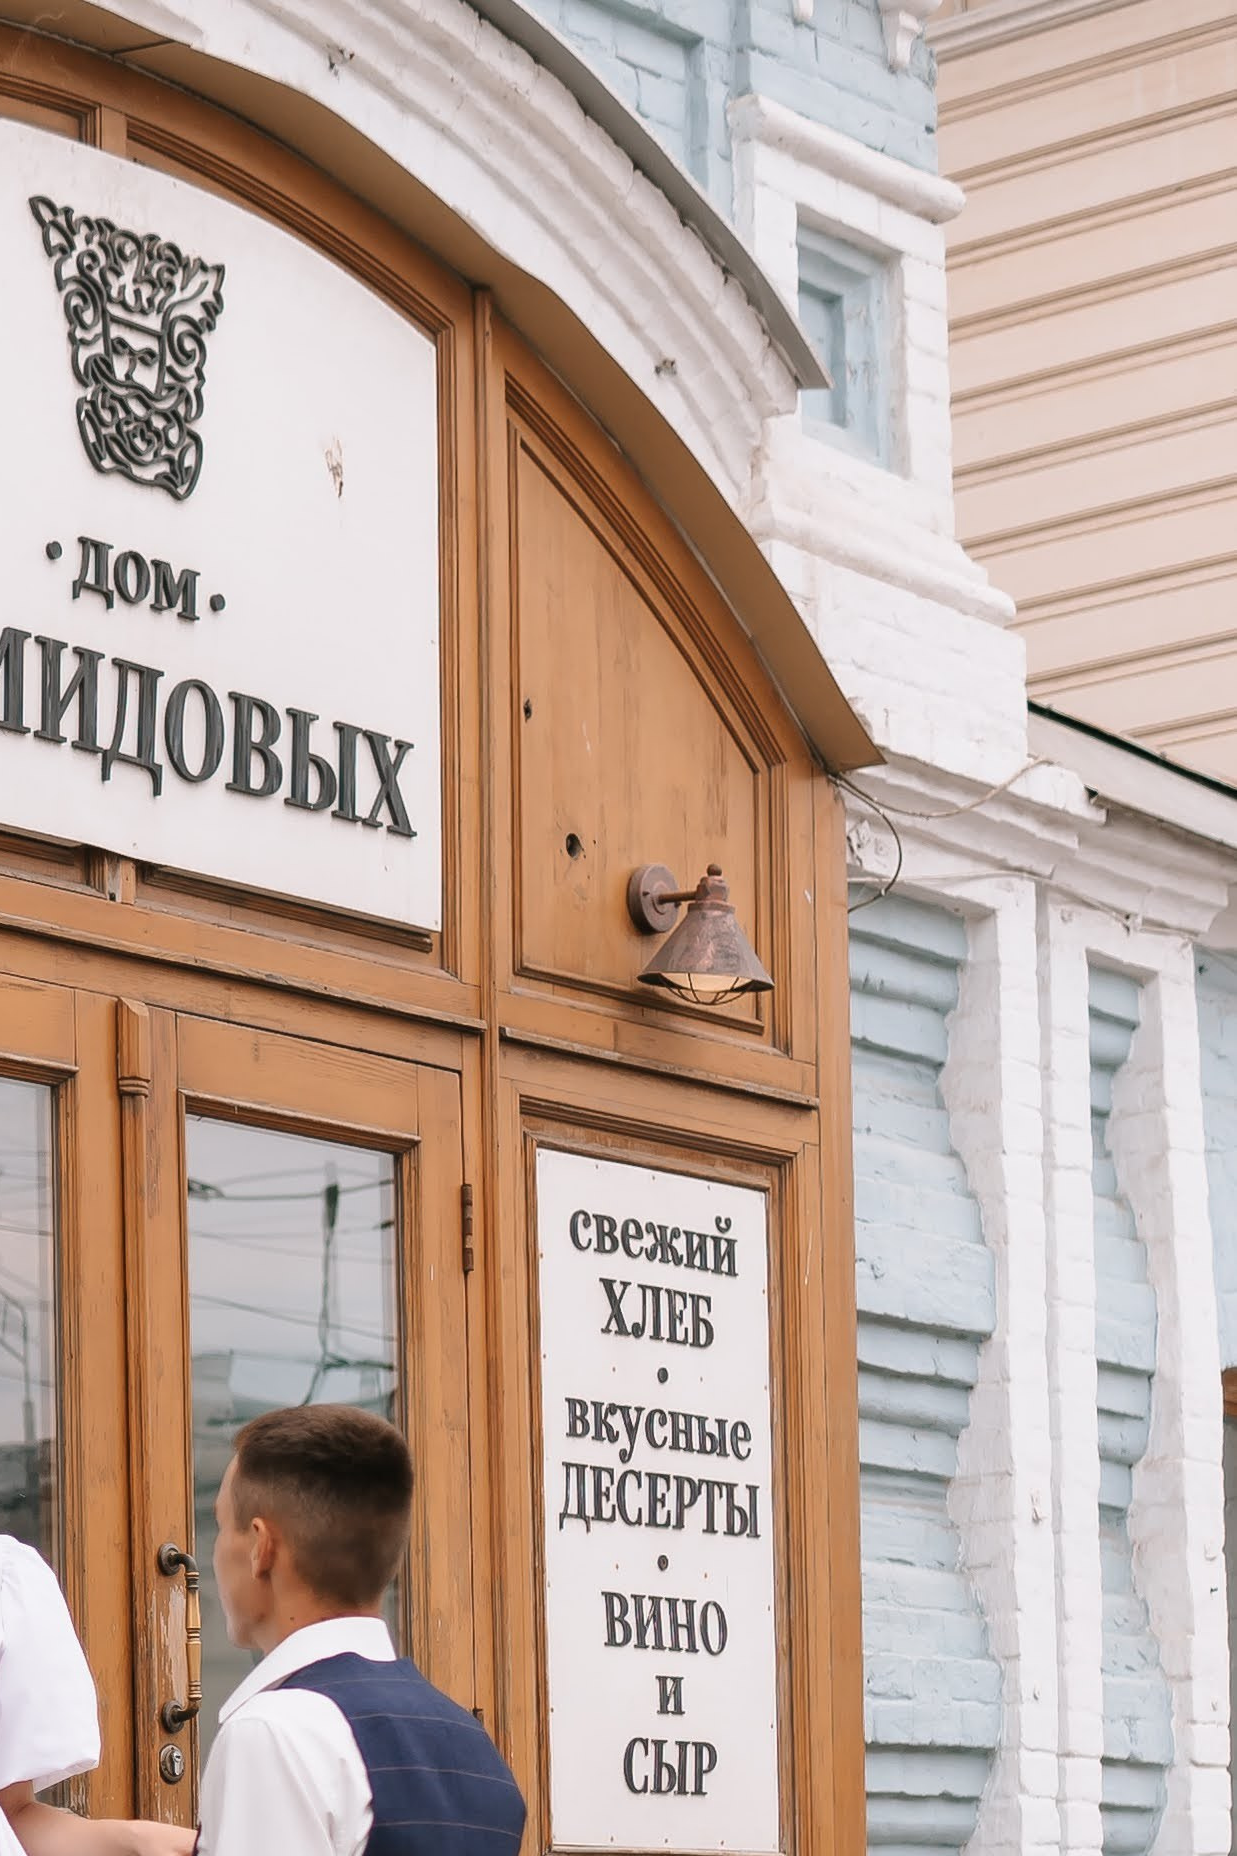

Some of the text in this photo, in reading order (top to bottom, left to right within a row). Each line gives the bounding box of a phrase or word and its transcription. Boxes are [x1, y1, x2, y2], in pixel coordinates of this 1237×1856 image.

[569, 1209, 739, 1278] свежий
[598, 1277, 715, 1349] ХЛЕБ
[564, 1396, 752, 1463] вкусные
[558, 1461, 761, 1540] ДЕСЕРТЫ
[600, 1591, 728, 1657] ВИНО
[622, 1736, 718, 1797] СЫР
